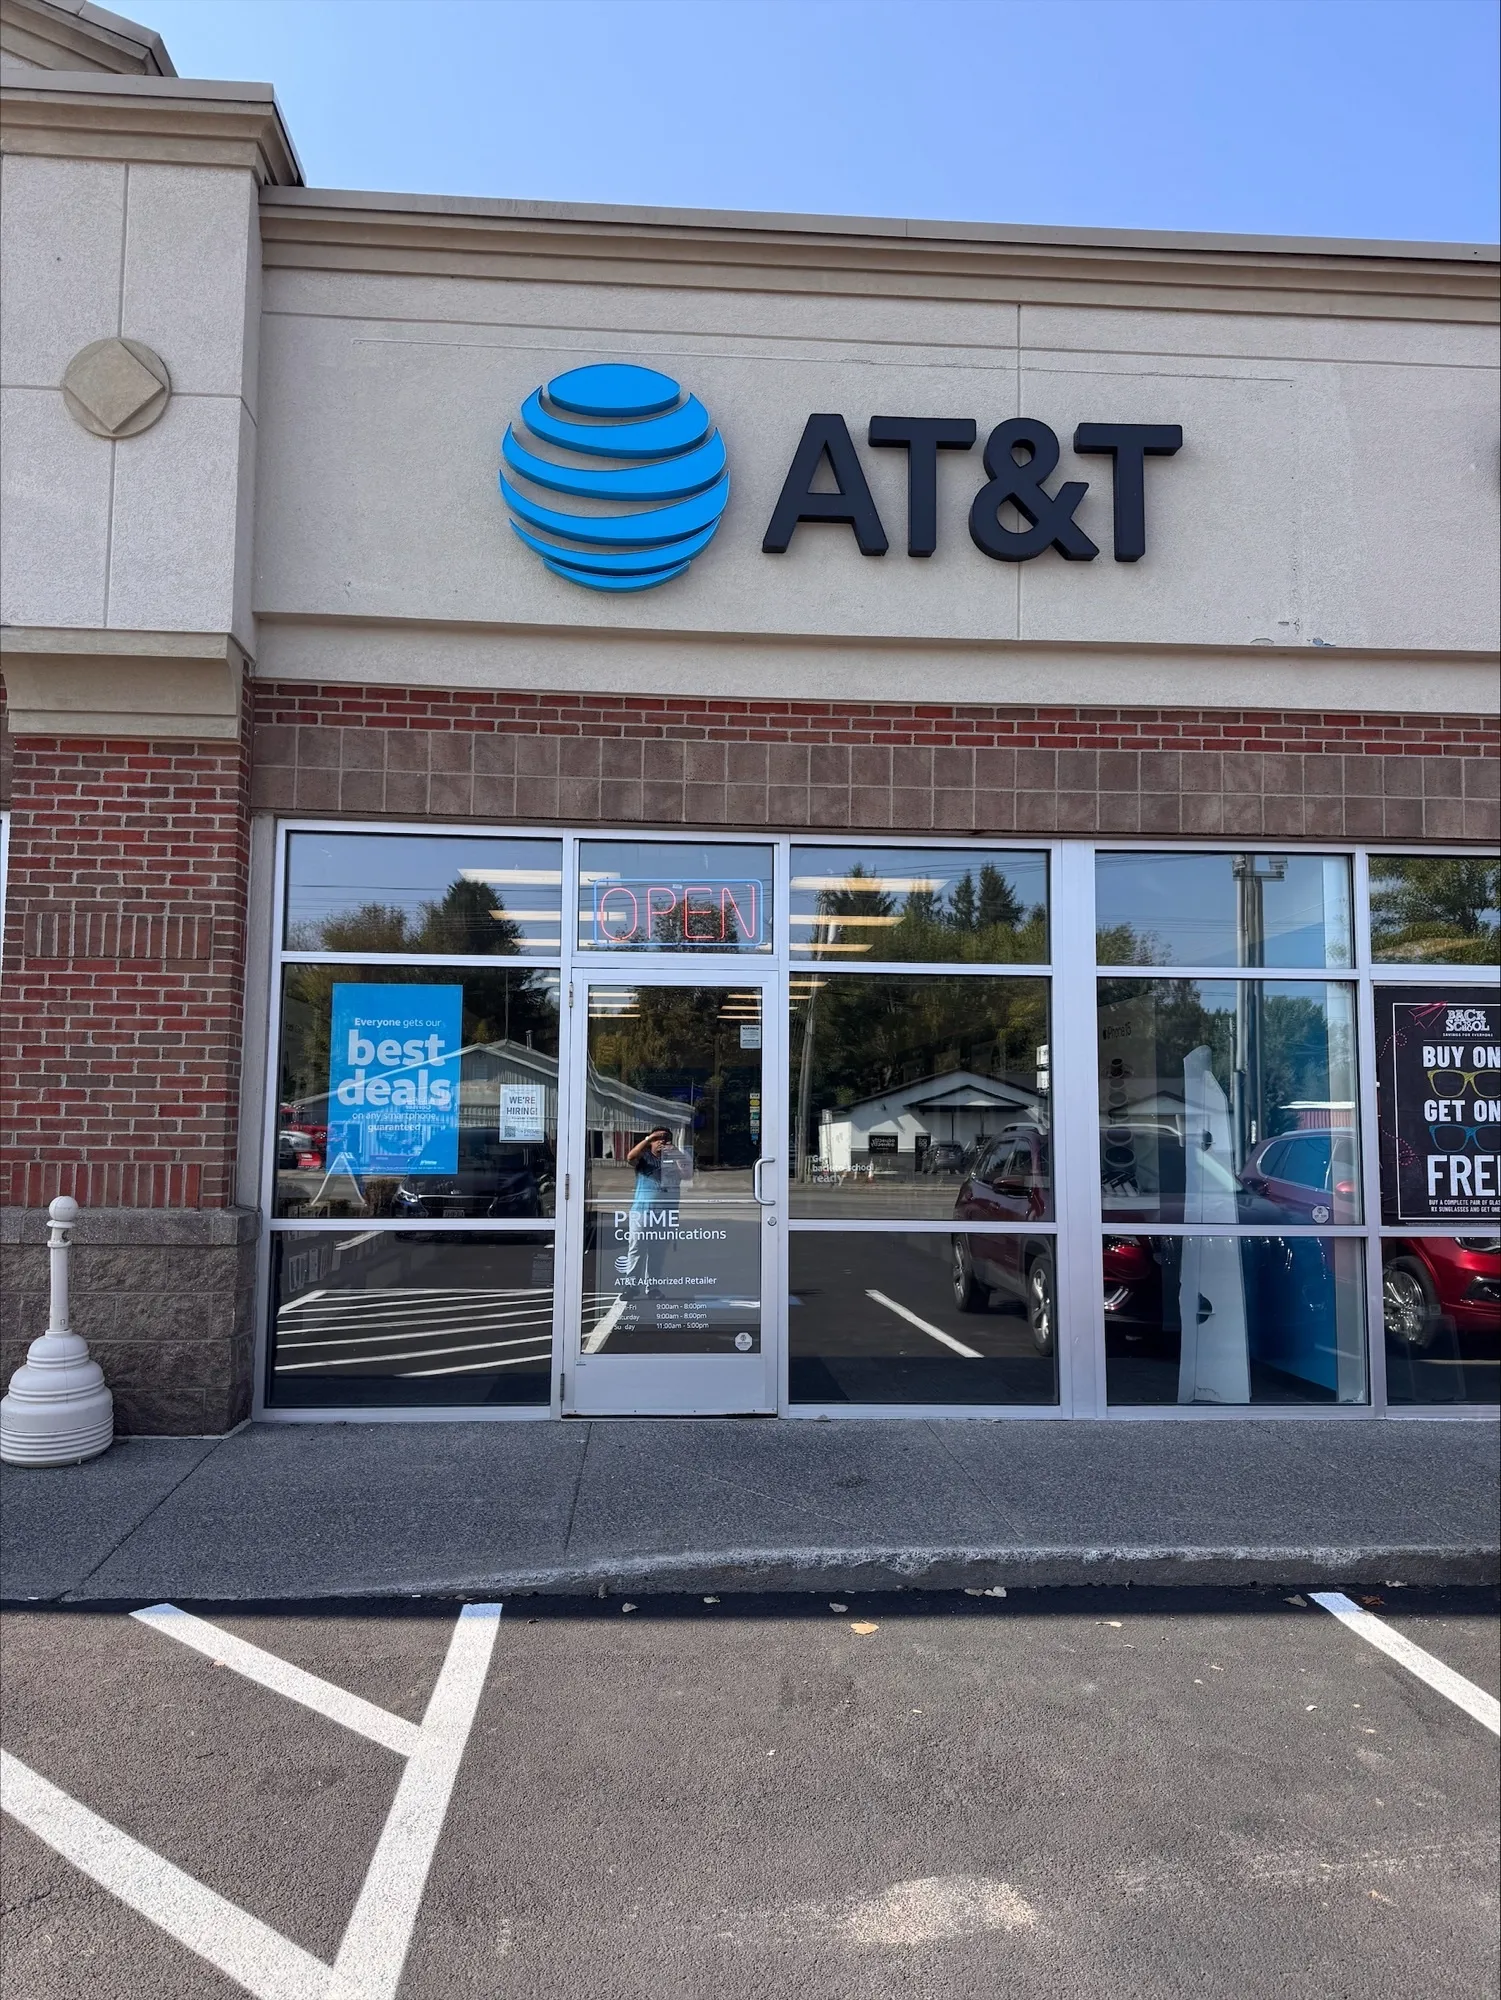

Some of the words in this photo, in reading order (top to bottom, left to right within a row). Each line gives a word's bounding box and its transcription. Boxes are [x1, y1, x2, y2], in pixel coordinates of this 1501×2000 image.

[762, 413, 1183, 563] AT&T
[601, 885, 755, 941] OPEN
[1447, 1009, 1486, 1021] BACK
[354, 1017, 401, 1028] Everyone
[403, 1018, 423, 1028] gets
[425, 1019, 442, 1027] our
[348, 1029, 445, 1066] best
[1423, 1046, 1464, 1068] BUY
[337, 1069, 451, 1107] deals
[509, 1096, 536, 1104] WE'RE
[352, 1112, 364, 1120] on
[366, 1112, 381, 1122] any
[506, 1107, 537, 1115] HIRING!
[1424, 1100, 1465, 1122] GET
[368, 1124, 420, 1132] guaranteed
[812, 1172, 844, 1184] ready
[1427, 1155, 1500, 1197] FRE
[614, 1210, 680, 1228] PRIME
[614, 1228, 727, 1241] Communications
[614, 1278, 636, 1287] AT&T
[637, 1277, 683, 1286] Authorized
[685, 1276, 717, 1285] Retailer
[684, 1303, 707, 1311] 8:00pm
[684, 1312, 707, 1320] 8:00pm
[687, 1322, 710, 1330] 5:00pm
